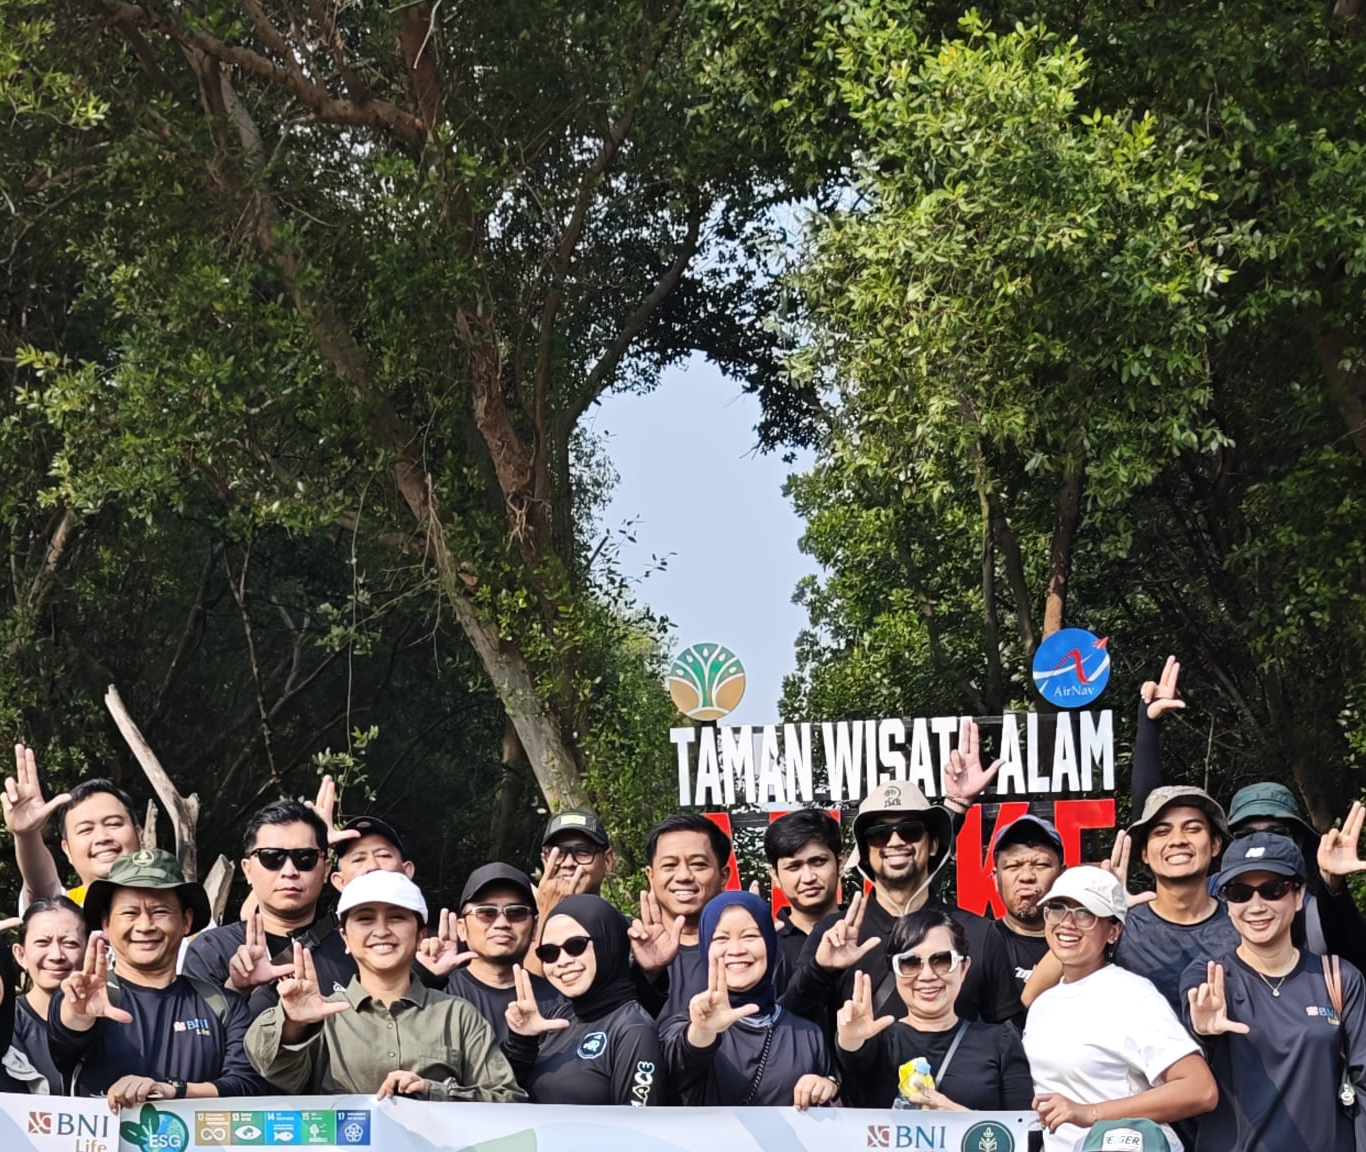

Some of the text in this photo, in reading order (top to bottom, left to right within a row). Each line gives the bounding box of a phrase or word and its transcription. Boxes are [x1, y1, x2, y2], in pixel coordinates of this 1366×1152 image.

[1053, 686, 1094, 696] AirNav
[669, 724, 813, 807] TAMAN
[996, 709, 1115, 795] ALAM
[630, 1060, 655, 1107] ACE
[57, 1113, 109, 1137] BNI
[895, 1125, 946, 1149] BNI
[149, 1134, 181, 1148] ESG
